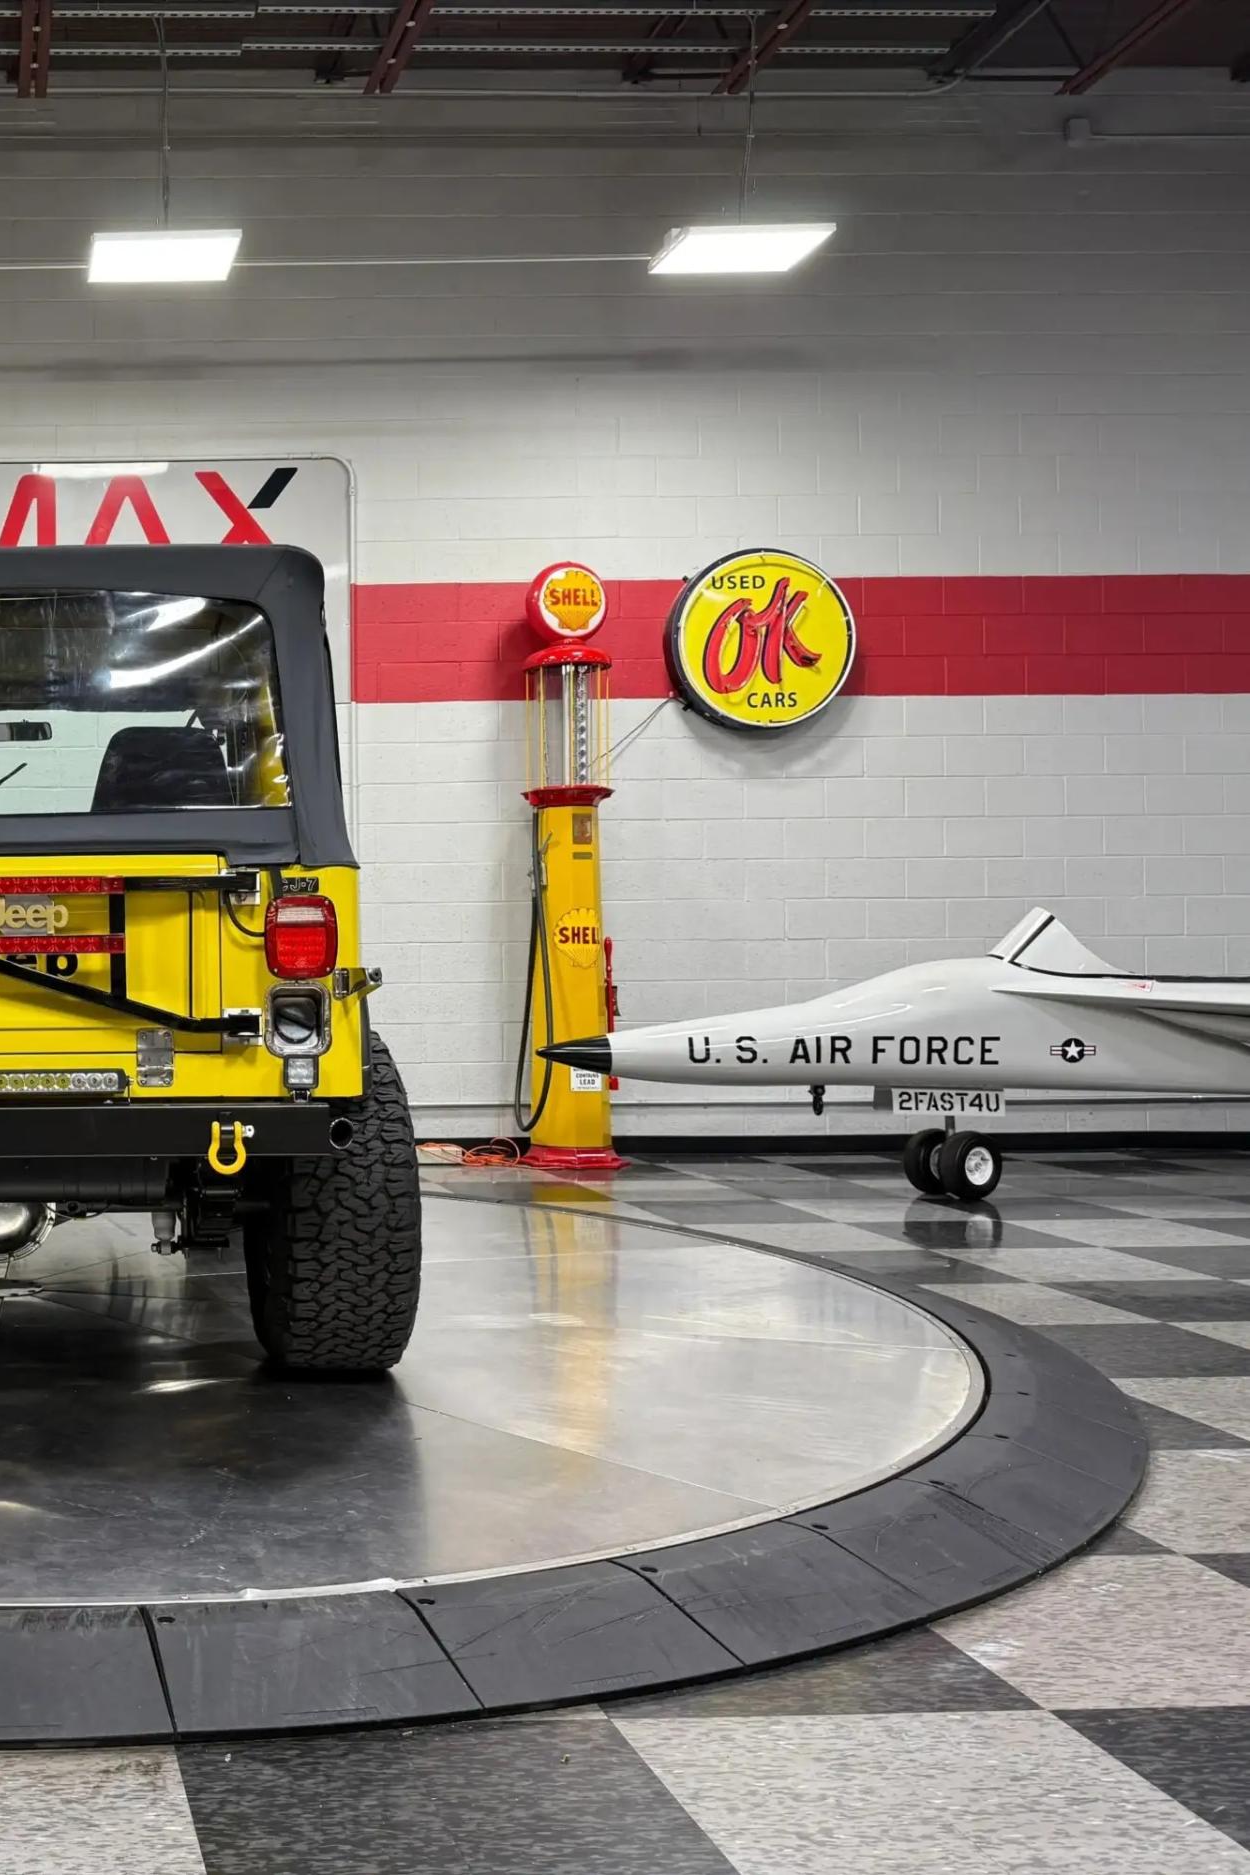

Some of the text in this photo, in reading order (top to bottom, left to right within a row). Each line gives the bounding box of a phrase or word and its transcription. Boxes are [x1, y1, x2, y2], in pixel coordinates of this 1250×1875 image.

[711, 575, 766, 590] USED
[549, 588, 599, 607] SHELL
[702, 577, 823, 694] OK
[747, 692, 798, 708] CARS
[687, 1035, 1000, 1065] U. S. AIR FORCE
[898, 1091, 1000, 1113] 2FAST4U
